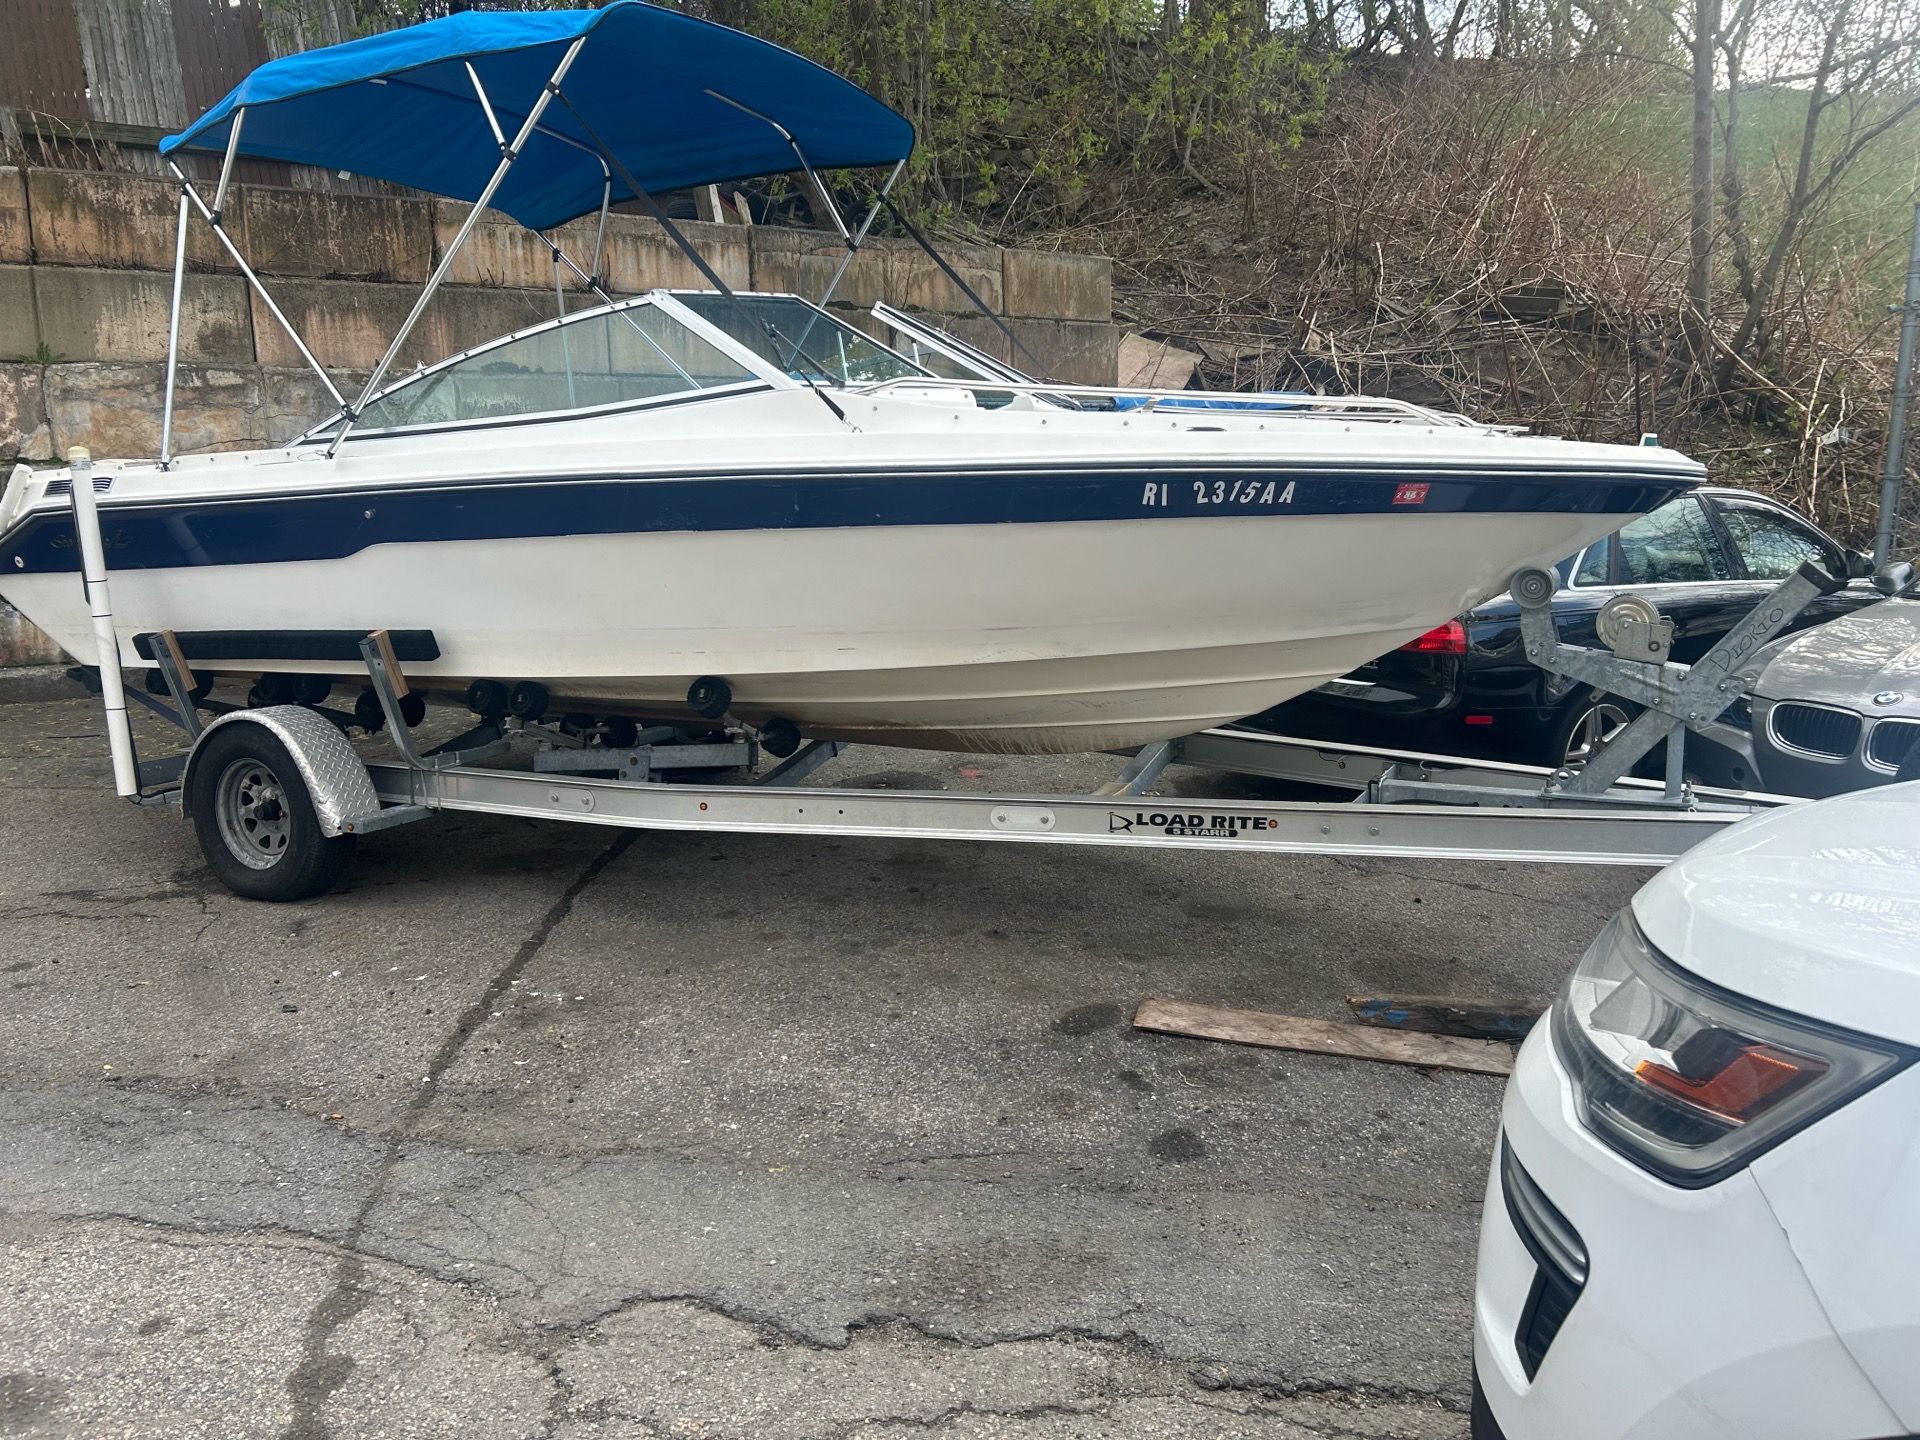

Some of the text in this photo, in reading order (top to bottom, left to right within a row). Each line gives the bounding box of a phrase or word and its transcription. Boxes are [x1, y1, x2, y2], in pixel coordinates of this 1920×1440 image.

[1142, 480, 1296, 506] RI 2315AA
[1136, 813, 1268, 830] LOAD RITE
[1184, 828, 1230, 837] STARR
